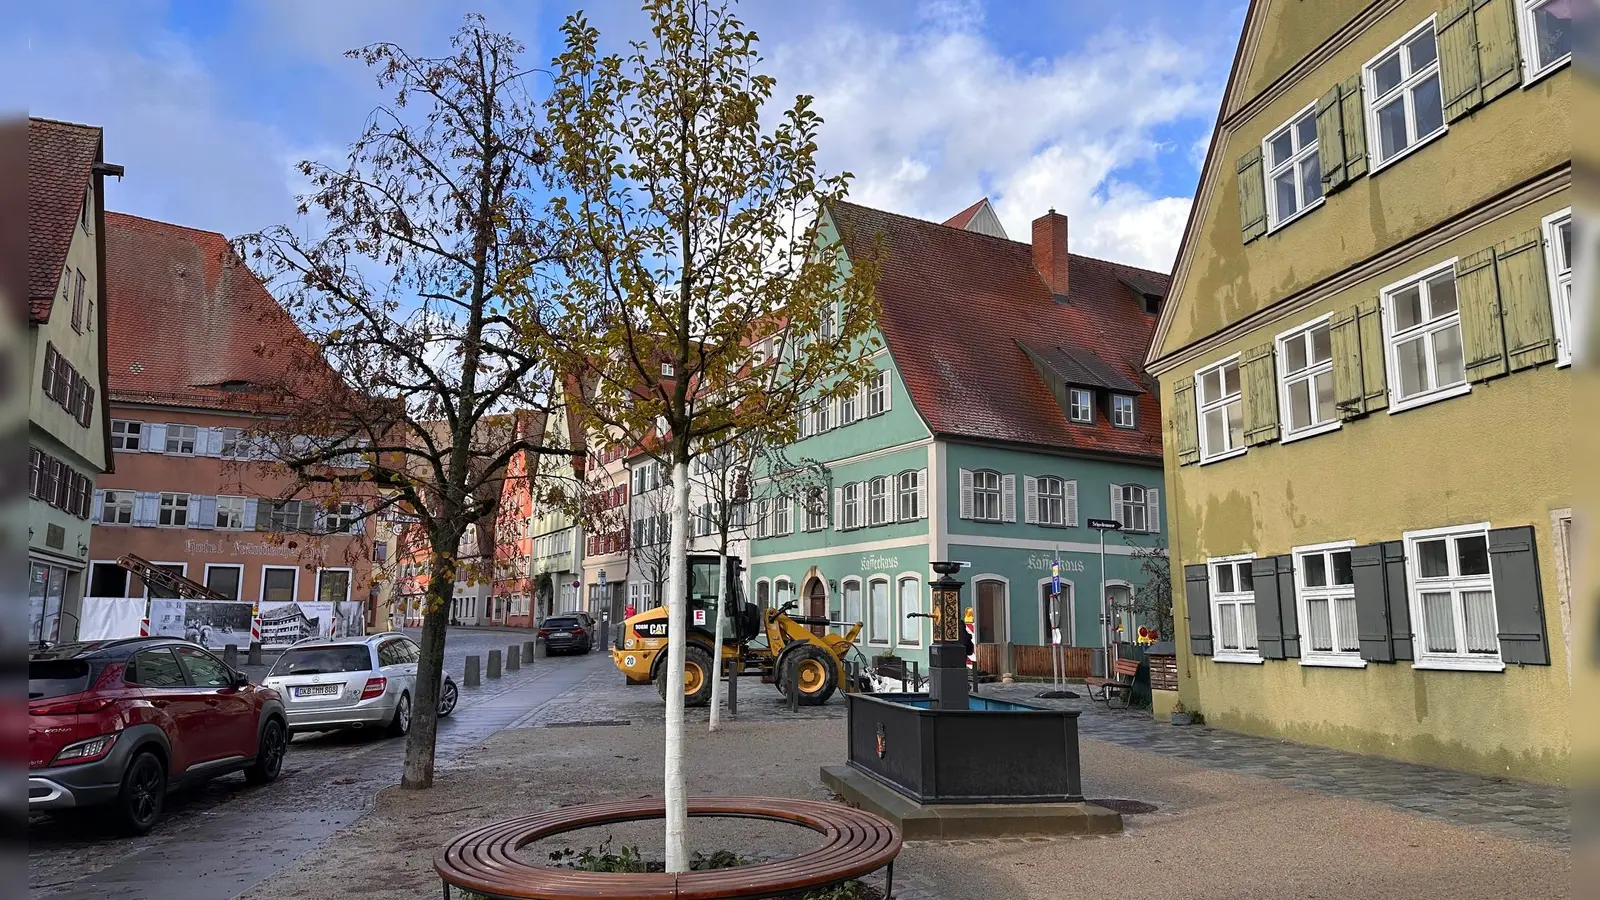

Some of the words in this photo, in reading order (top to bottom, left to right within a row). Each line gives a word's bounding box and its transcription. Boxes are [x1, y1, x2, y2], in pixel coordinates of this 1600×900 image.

[860, 553, 899, 572] Kaffeehaus
[649, 623, 668, 635] CAT
[626, 656, 635, 666] 20
